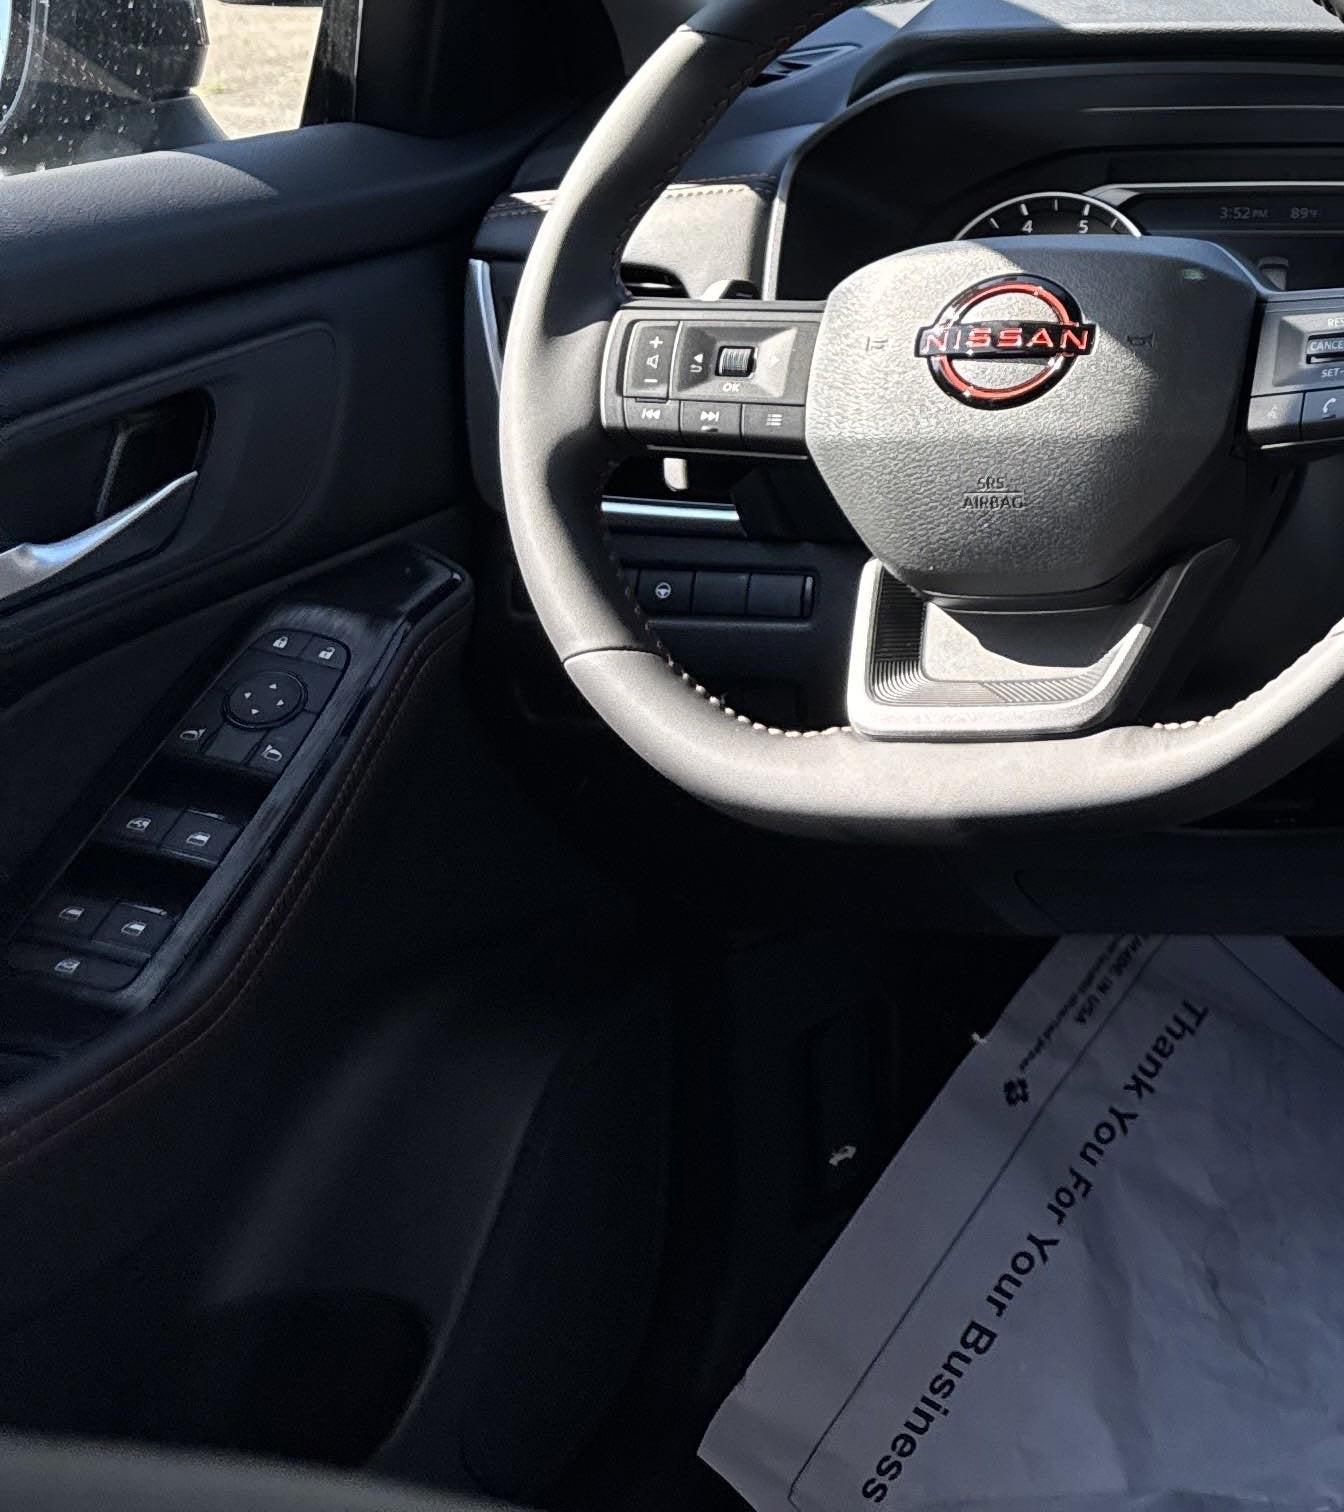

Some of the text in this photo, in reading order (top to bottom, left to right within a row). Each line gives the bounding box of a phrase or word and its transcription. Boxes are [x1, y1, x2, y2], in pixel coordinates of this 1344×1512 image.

[1218, 207, 1250, 219] 3:52
[1021, 219, 1033, 233] 4
[1078, 219, 1089, 234] 5
[921, 326, 1089, 354] NISSAN
[722, 382, 741, 393] OK
[977, 476, 1005, 489] SRS
[960, 495, 1024, 509] AIRBAG
[1096, 975, 1114, 995] IN
[1073, 993, 1101, 1026] USA
[860, 999, 1209, 1506] Thank You For Your Business
